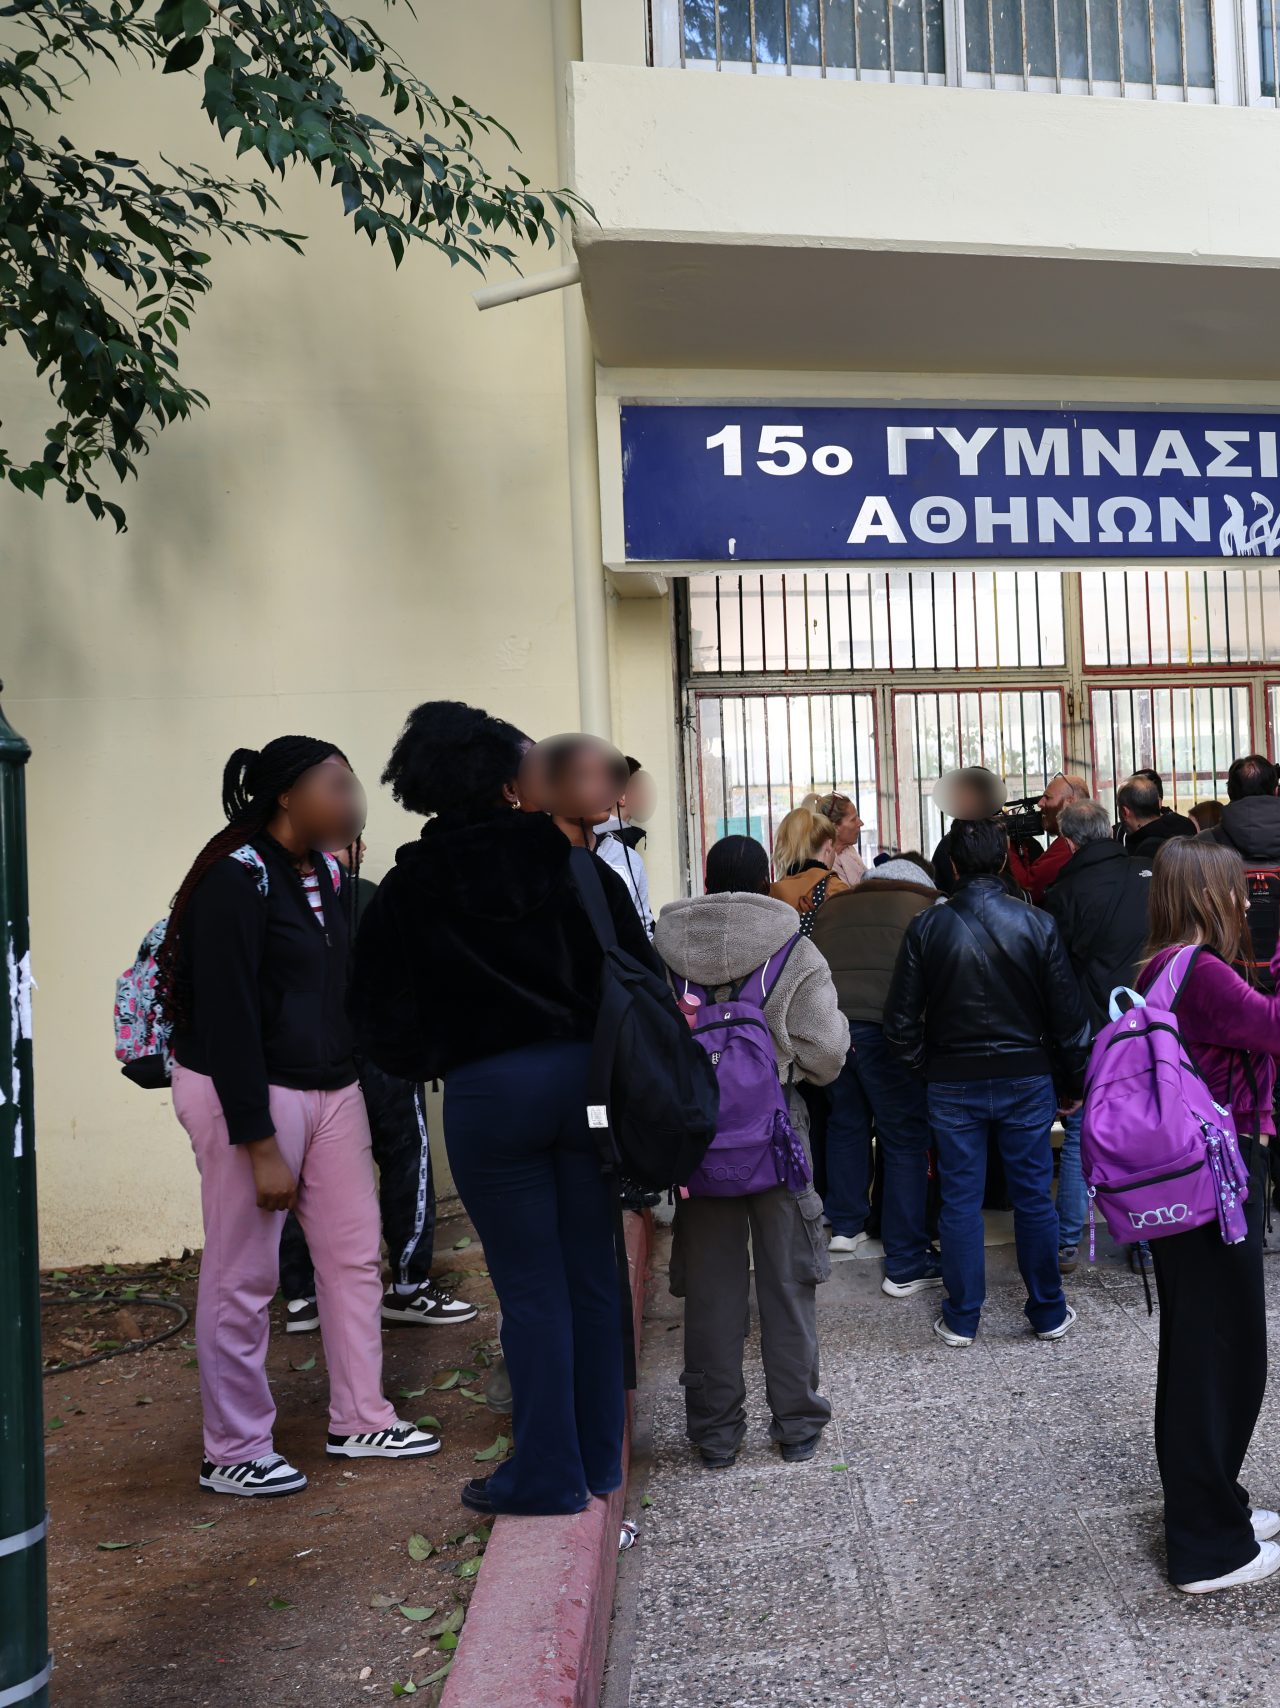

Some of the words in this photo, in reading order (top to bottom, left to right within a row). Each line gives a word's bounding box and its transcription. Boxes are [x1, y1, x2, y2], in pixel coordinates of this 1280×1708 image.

[706, 424, 854, 477] 15ο
[846, 495, 1211, 544] ΑΘΗΝΩΝ
[1128, 1203, 1188, 1229] POLO
